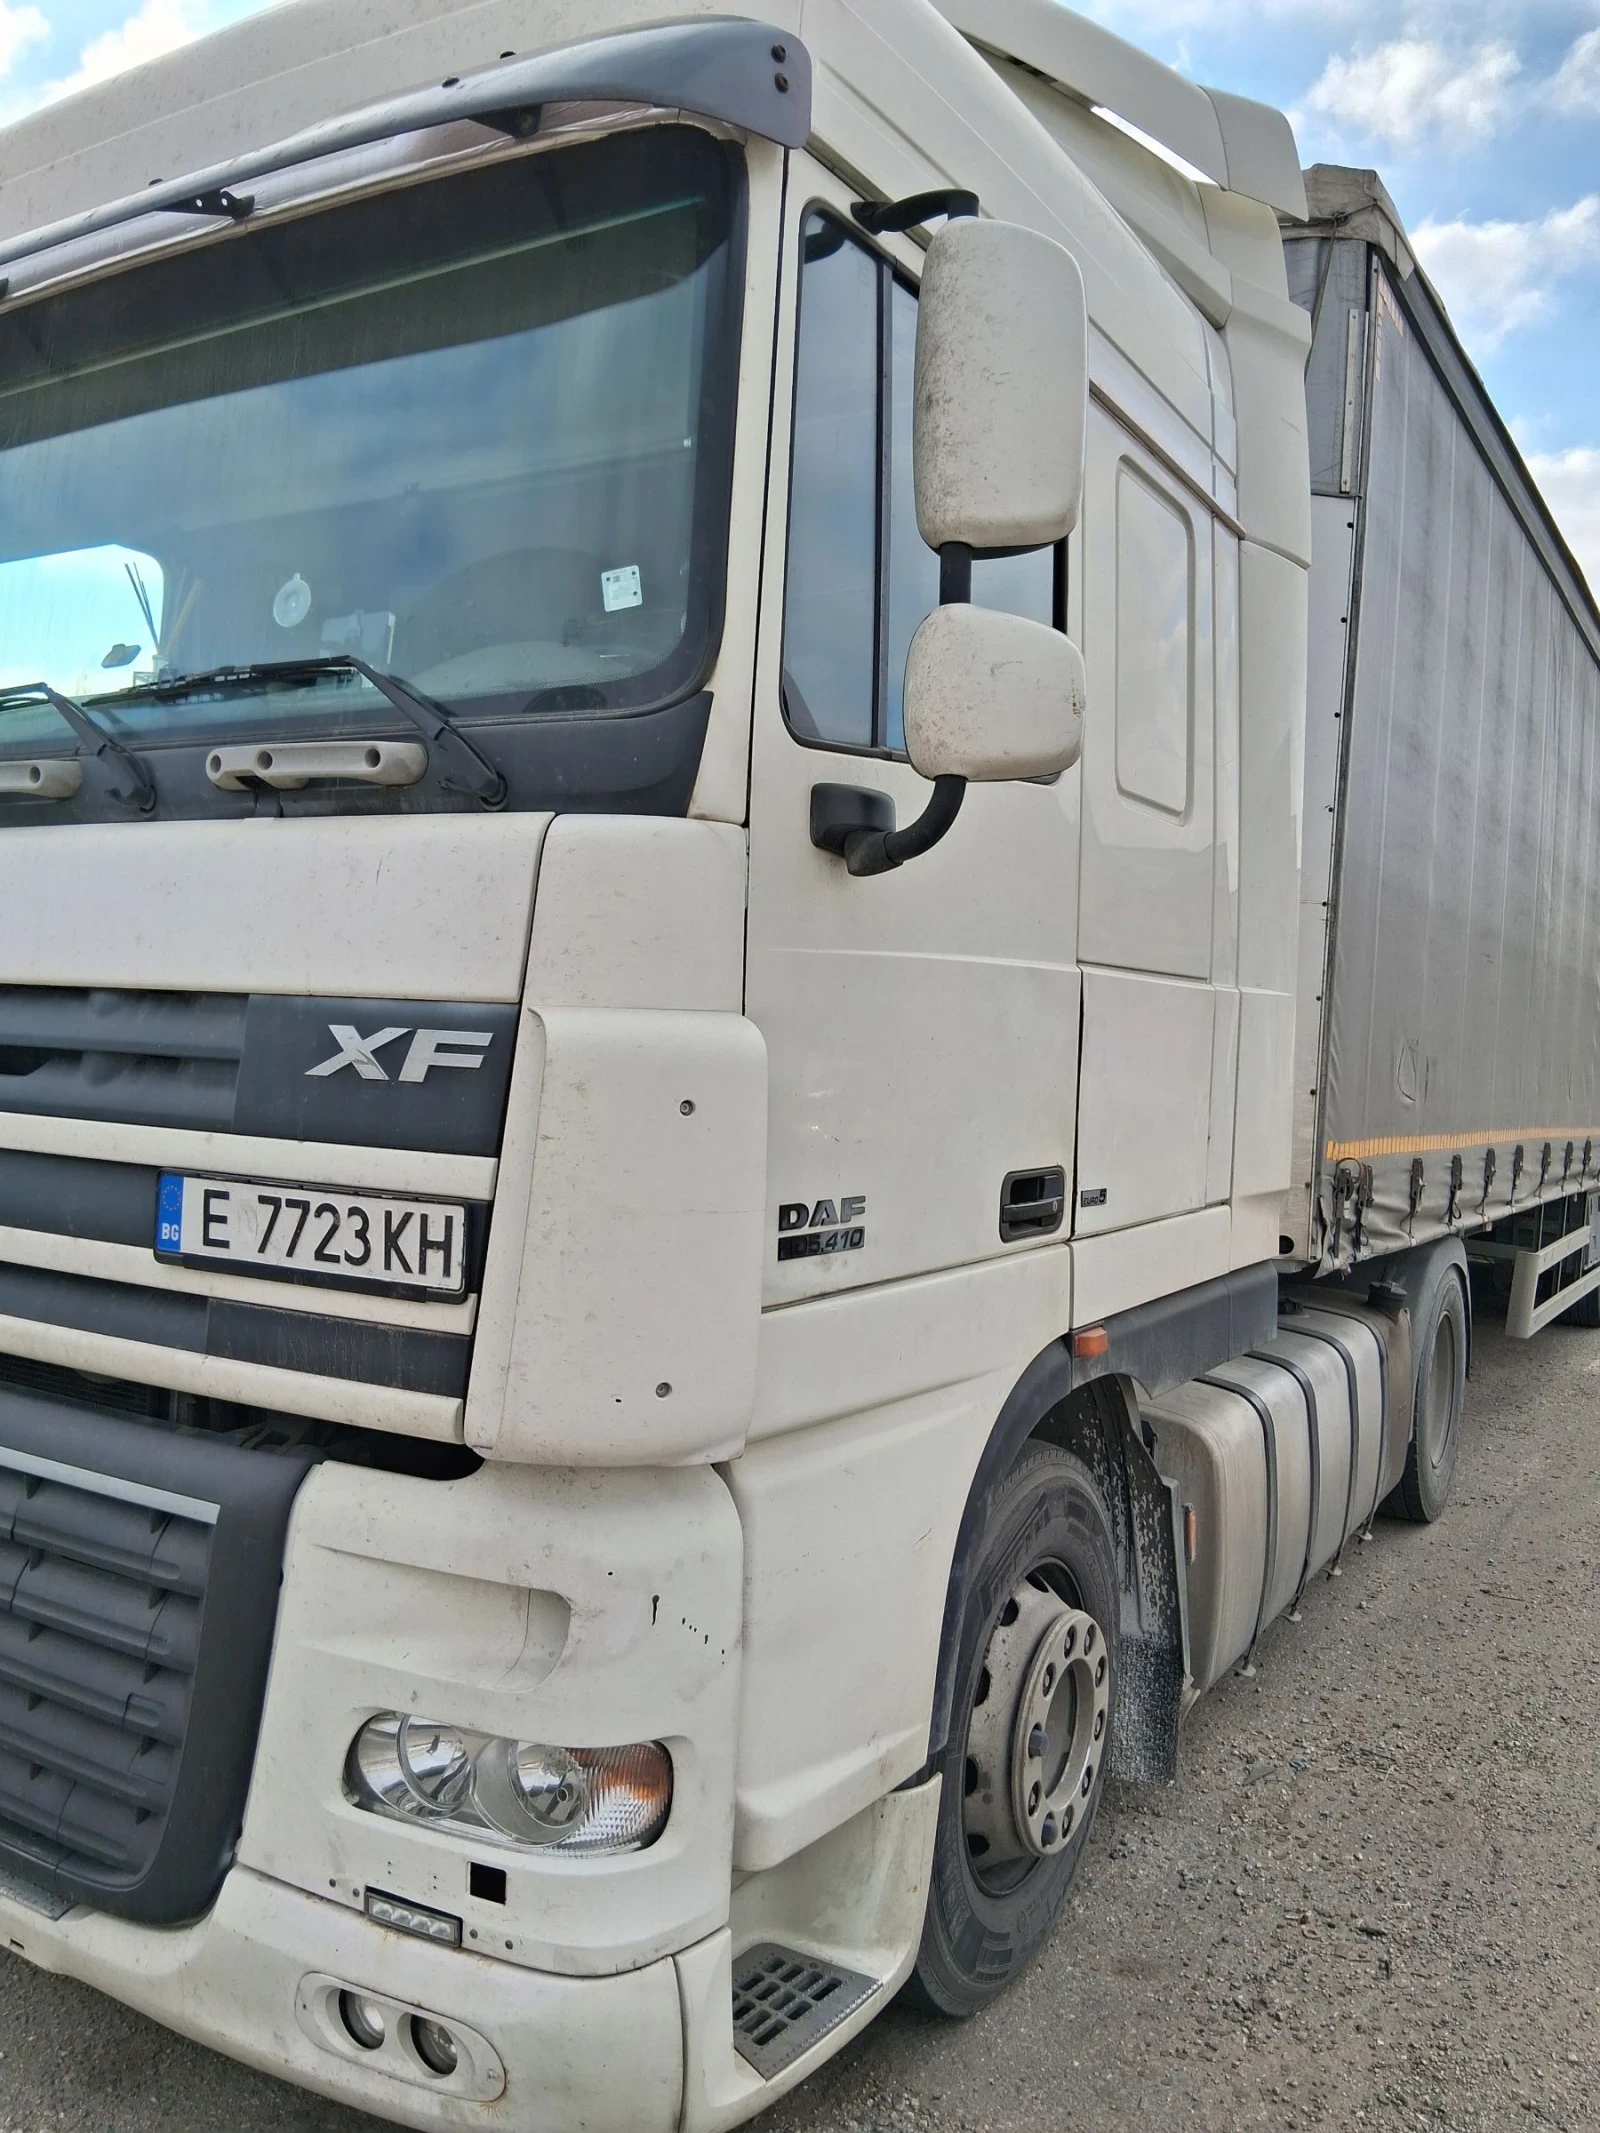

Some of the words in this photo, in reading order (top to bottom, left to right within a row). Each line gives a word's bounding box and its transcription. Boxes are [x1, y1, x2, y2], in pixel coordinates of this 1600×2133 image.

[305, 1024, 495, 1083] XF
[161, 1222, 180, 1241] BG
[202, 1188, 231, 1250] E
[257, 1194, 372, 1267] 7723
[383, 1210, 454, 1278] KH
[778, 1195, 867, 1231] DAF
